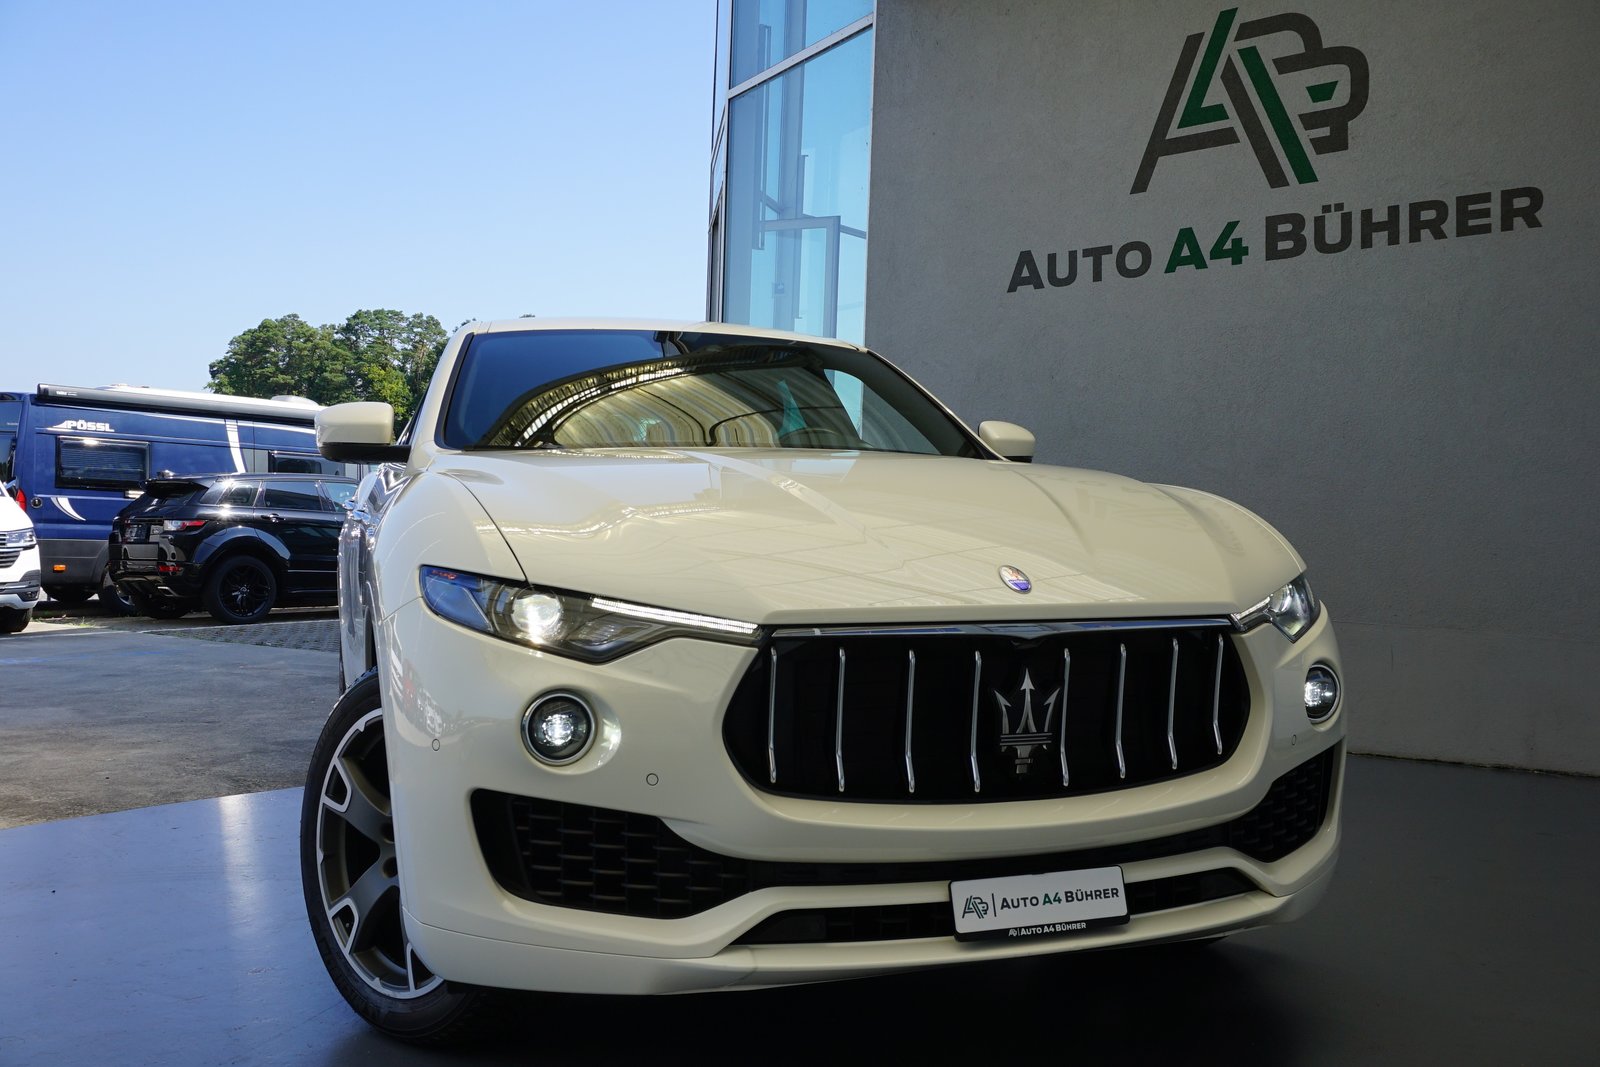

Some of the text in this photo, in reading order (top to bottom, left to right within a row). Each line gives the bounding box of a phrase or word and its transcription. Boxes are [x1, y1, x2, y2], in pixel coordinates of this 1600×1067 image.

[1006, 186, 1544, 293] AUTO A4 BÜHRER
[66, 419, 115, 432] PÖSSL
[1000, 896, 1039, 910] AUTO
[1042, 892, 1062, 906] A4
[1064, 887, 1119, 903] BÜHRER
[1020, 927, 1042, 936] AUTO
[1043, 925, 1055, 933] A4
[1055, 922, 1087, 932] BÜHRER
